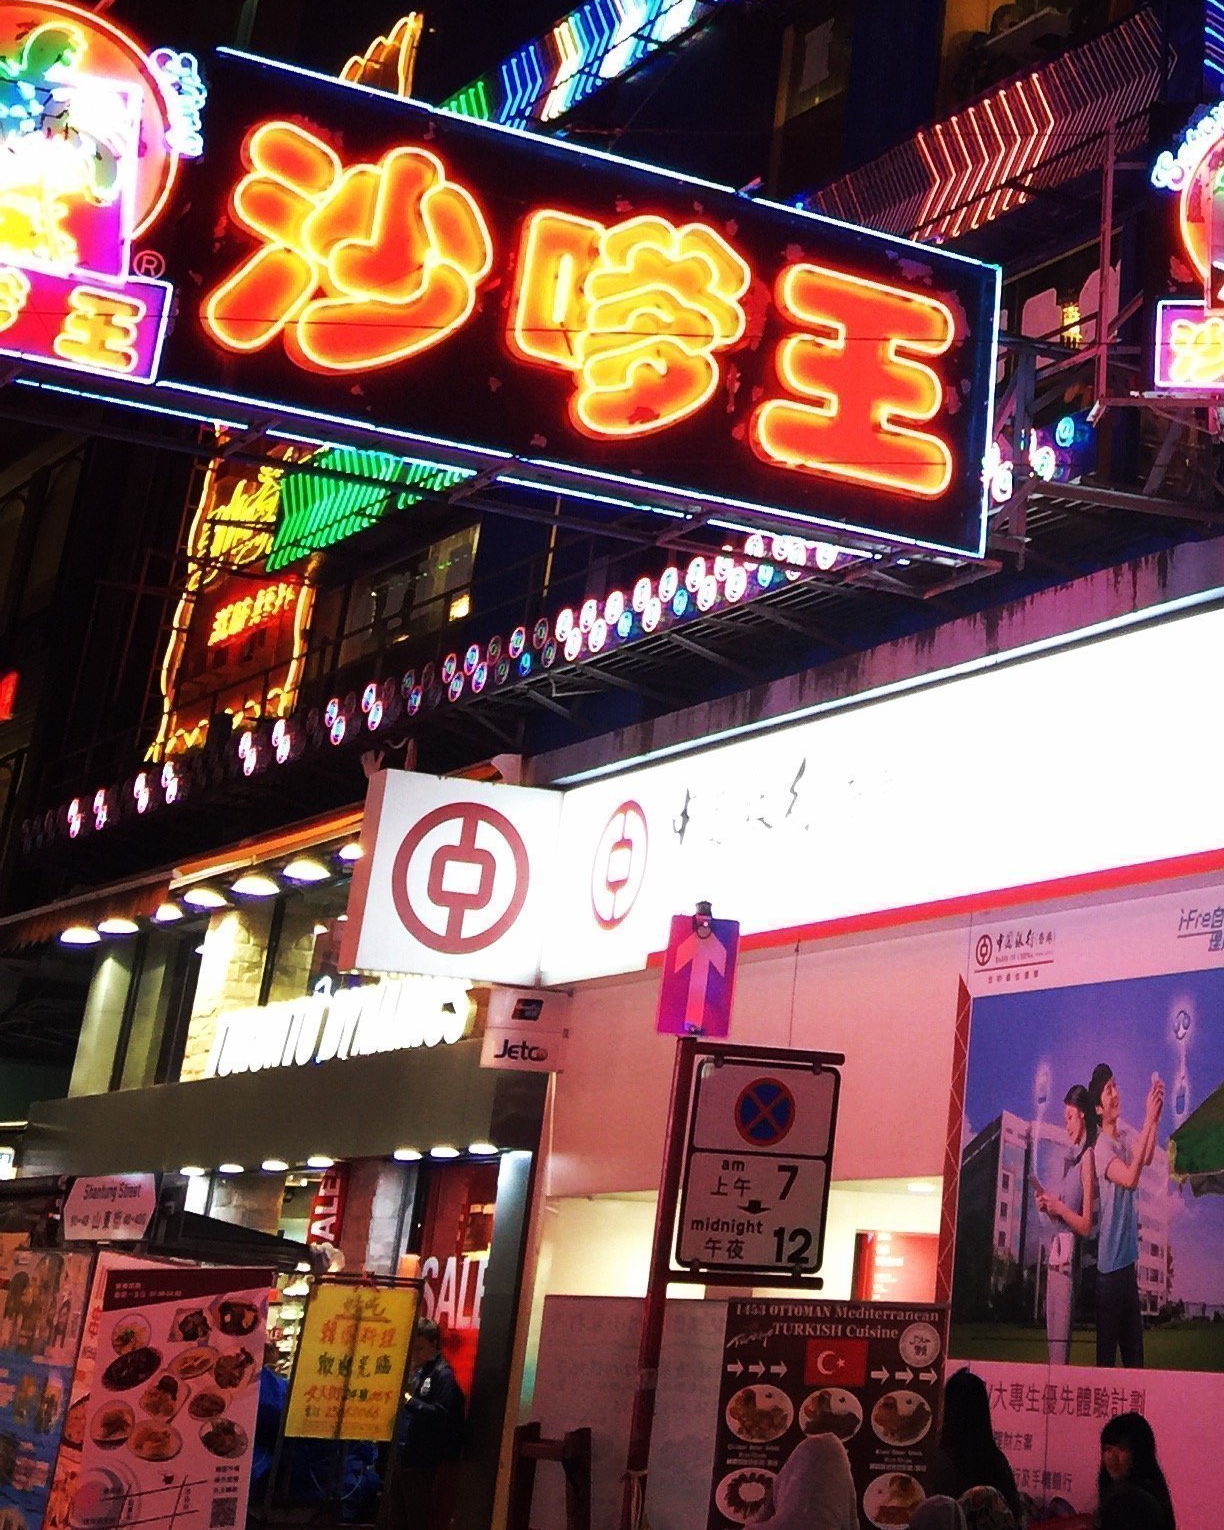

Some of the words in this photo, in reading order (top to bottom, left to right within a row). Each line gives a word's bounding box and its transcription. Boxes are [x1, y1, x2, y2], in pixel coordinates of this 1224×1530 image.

[202, 119, 957, 500] 沙嗲王
[721, 1159, 746, 1172] am
[710, 1176, 751, 1198] 上午
[777, 1164, 799, 1201] 7
[690, 1217, 764, 1236] midnight
[704, 1237, 746, 1260] 午夜
[772, 1226, 813, 1265] 12
[769, 1305, 831, 1318] OTTOMAN
[836, 1307, 940, 1322] Mediterranean
[772, 1322, 842, 1337] TURKISH
[846, 1326, 899, 1339] Cuisine
